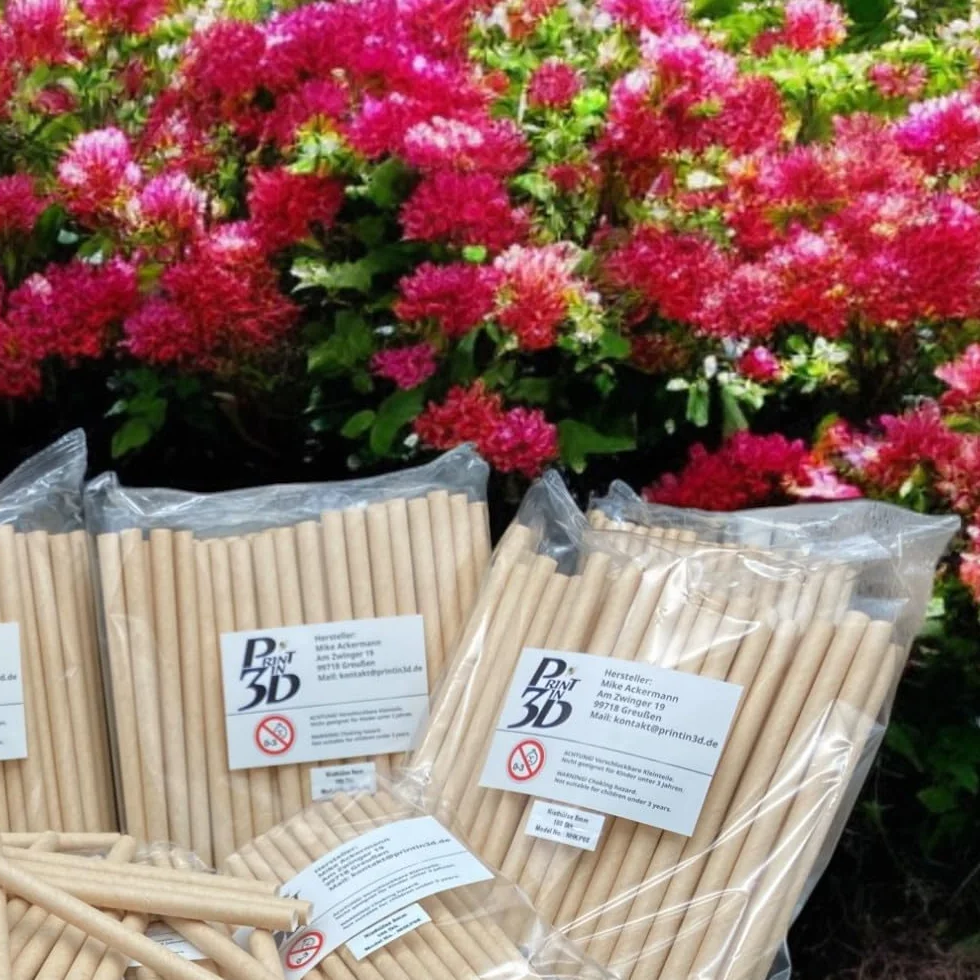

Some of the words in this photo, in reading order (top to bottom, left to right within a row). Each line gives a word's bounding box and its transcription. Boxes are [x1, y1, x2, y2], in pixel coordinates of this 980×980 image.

[314, 632, 355, 642] Hersteller:
[315, 644, 335, 652] Mike
[337, 639, 381, 650] Ackermann
[316, 654, 329, 662] Am
[331, 651, 363, 662] Zwinger
[317, 662, 339, 671] 99718
[341, 659, 375, 669] Greußen
[318, 673, 337, 681] Mail:
[339, 664, 422, 679] kontakt@printin3d.de
[603, 669, 653, 685] Hersteller:
[600, 680, 623, 691] Mike
[623, 685, 679, 703] Ackermann
[596, 690, 613, 700] Am
[612, 693, 653, 709] Zwinger
[653, 702, 666, 711] 19
[593, 700, 620, 713] 99718
[620, 706, 663, 722] Greußen
[589, 711, 612, 722] Mail:
[611, 715, 720, 748] kontakt@printin3d.de
[651, 802, 672, 813] years.
